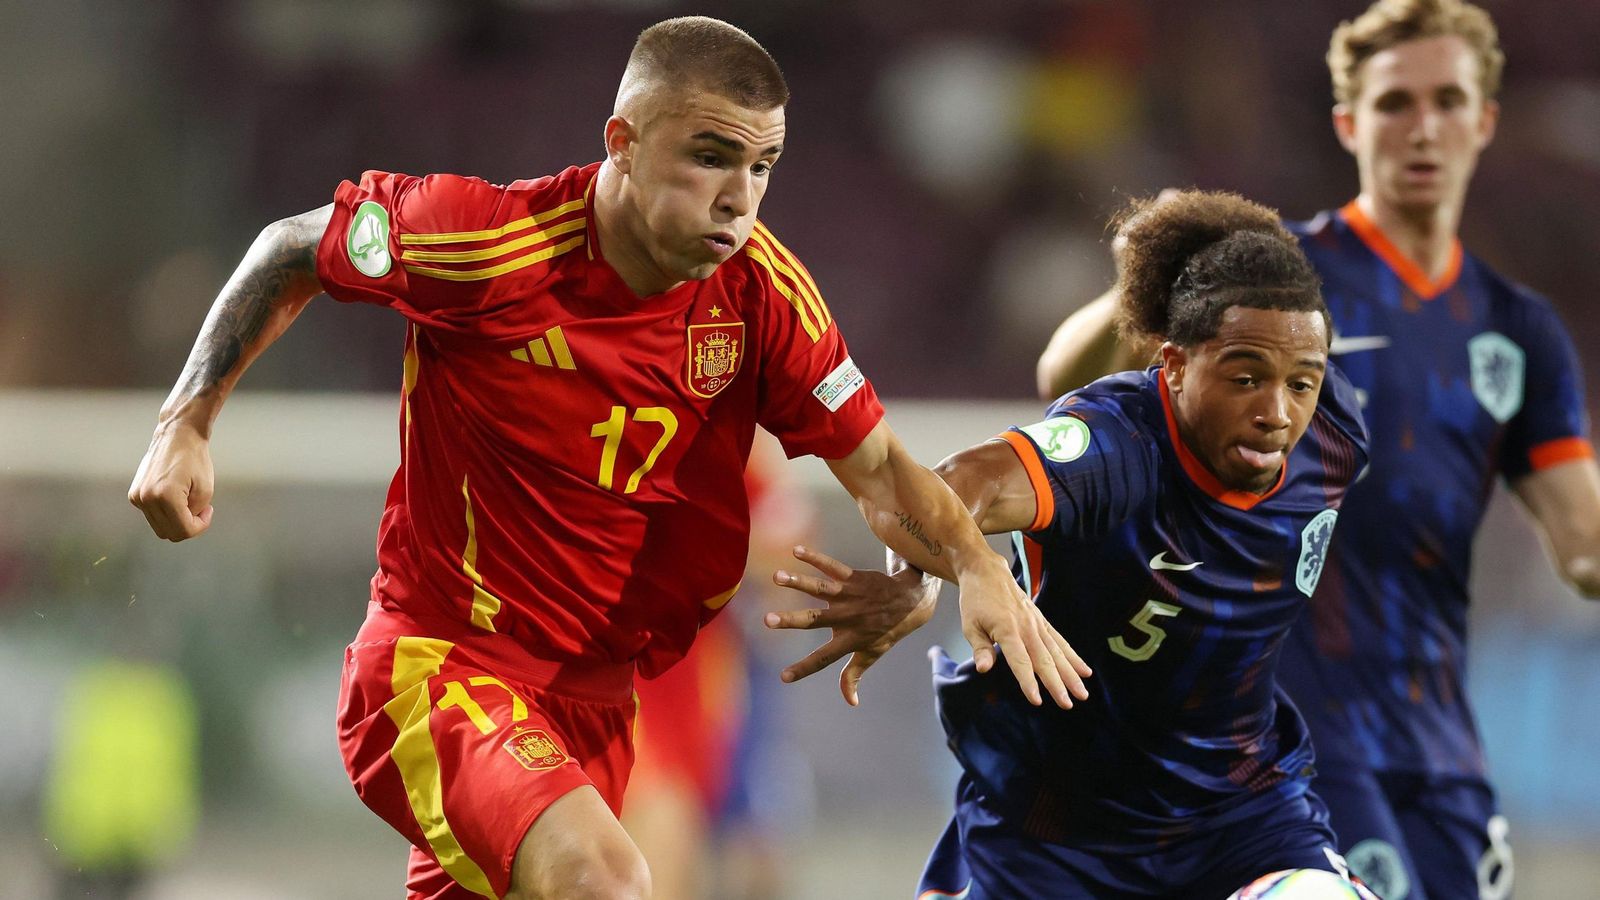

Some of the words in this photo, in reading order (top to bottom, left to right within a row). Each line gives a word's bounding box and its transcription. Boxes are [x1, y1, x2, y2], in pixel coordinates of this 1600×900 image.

[590, 405, 679, 494] 17
[1107, 599, 1183, 662] 5
[436, 676, 529, 736] 17
